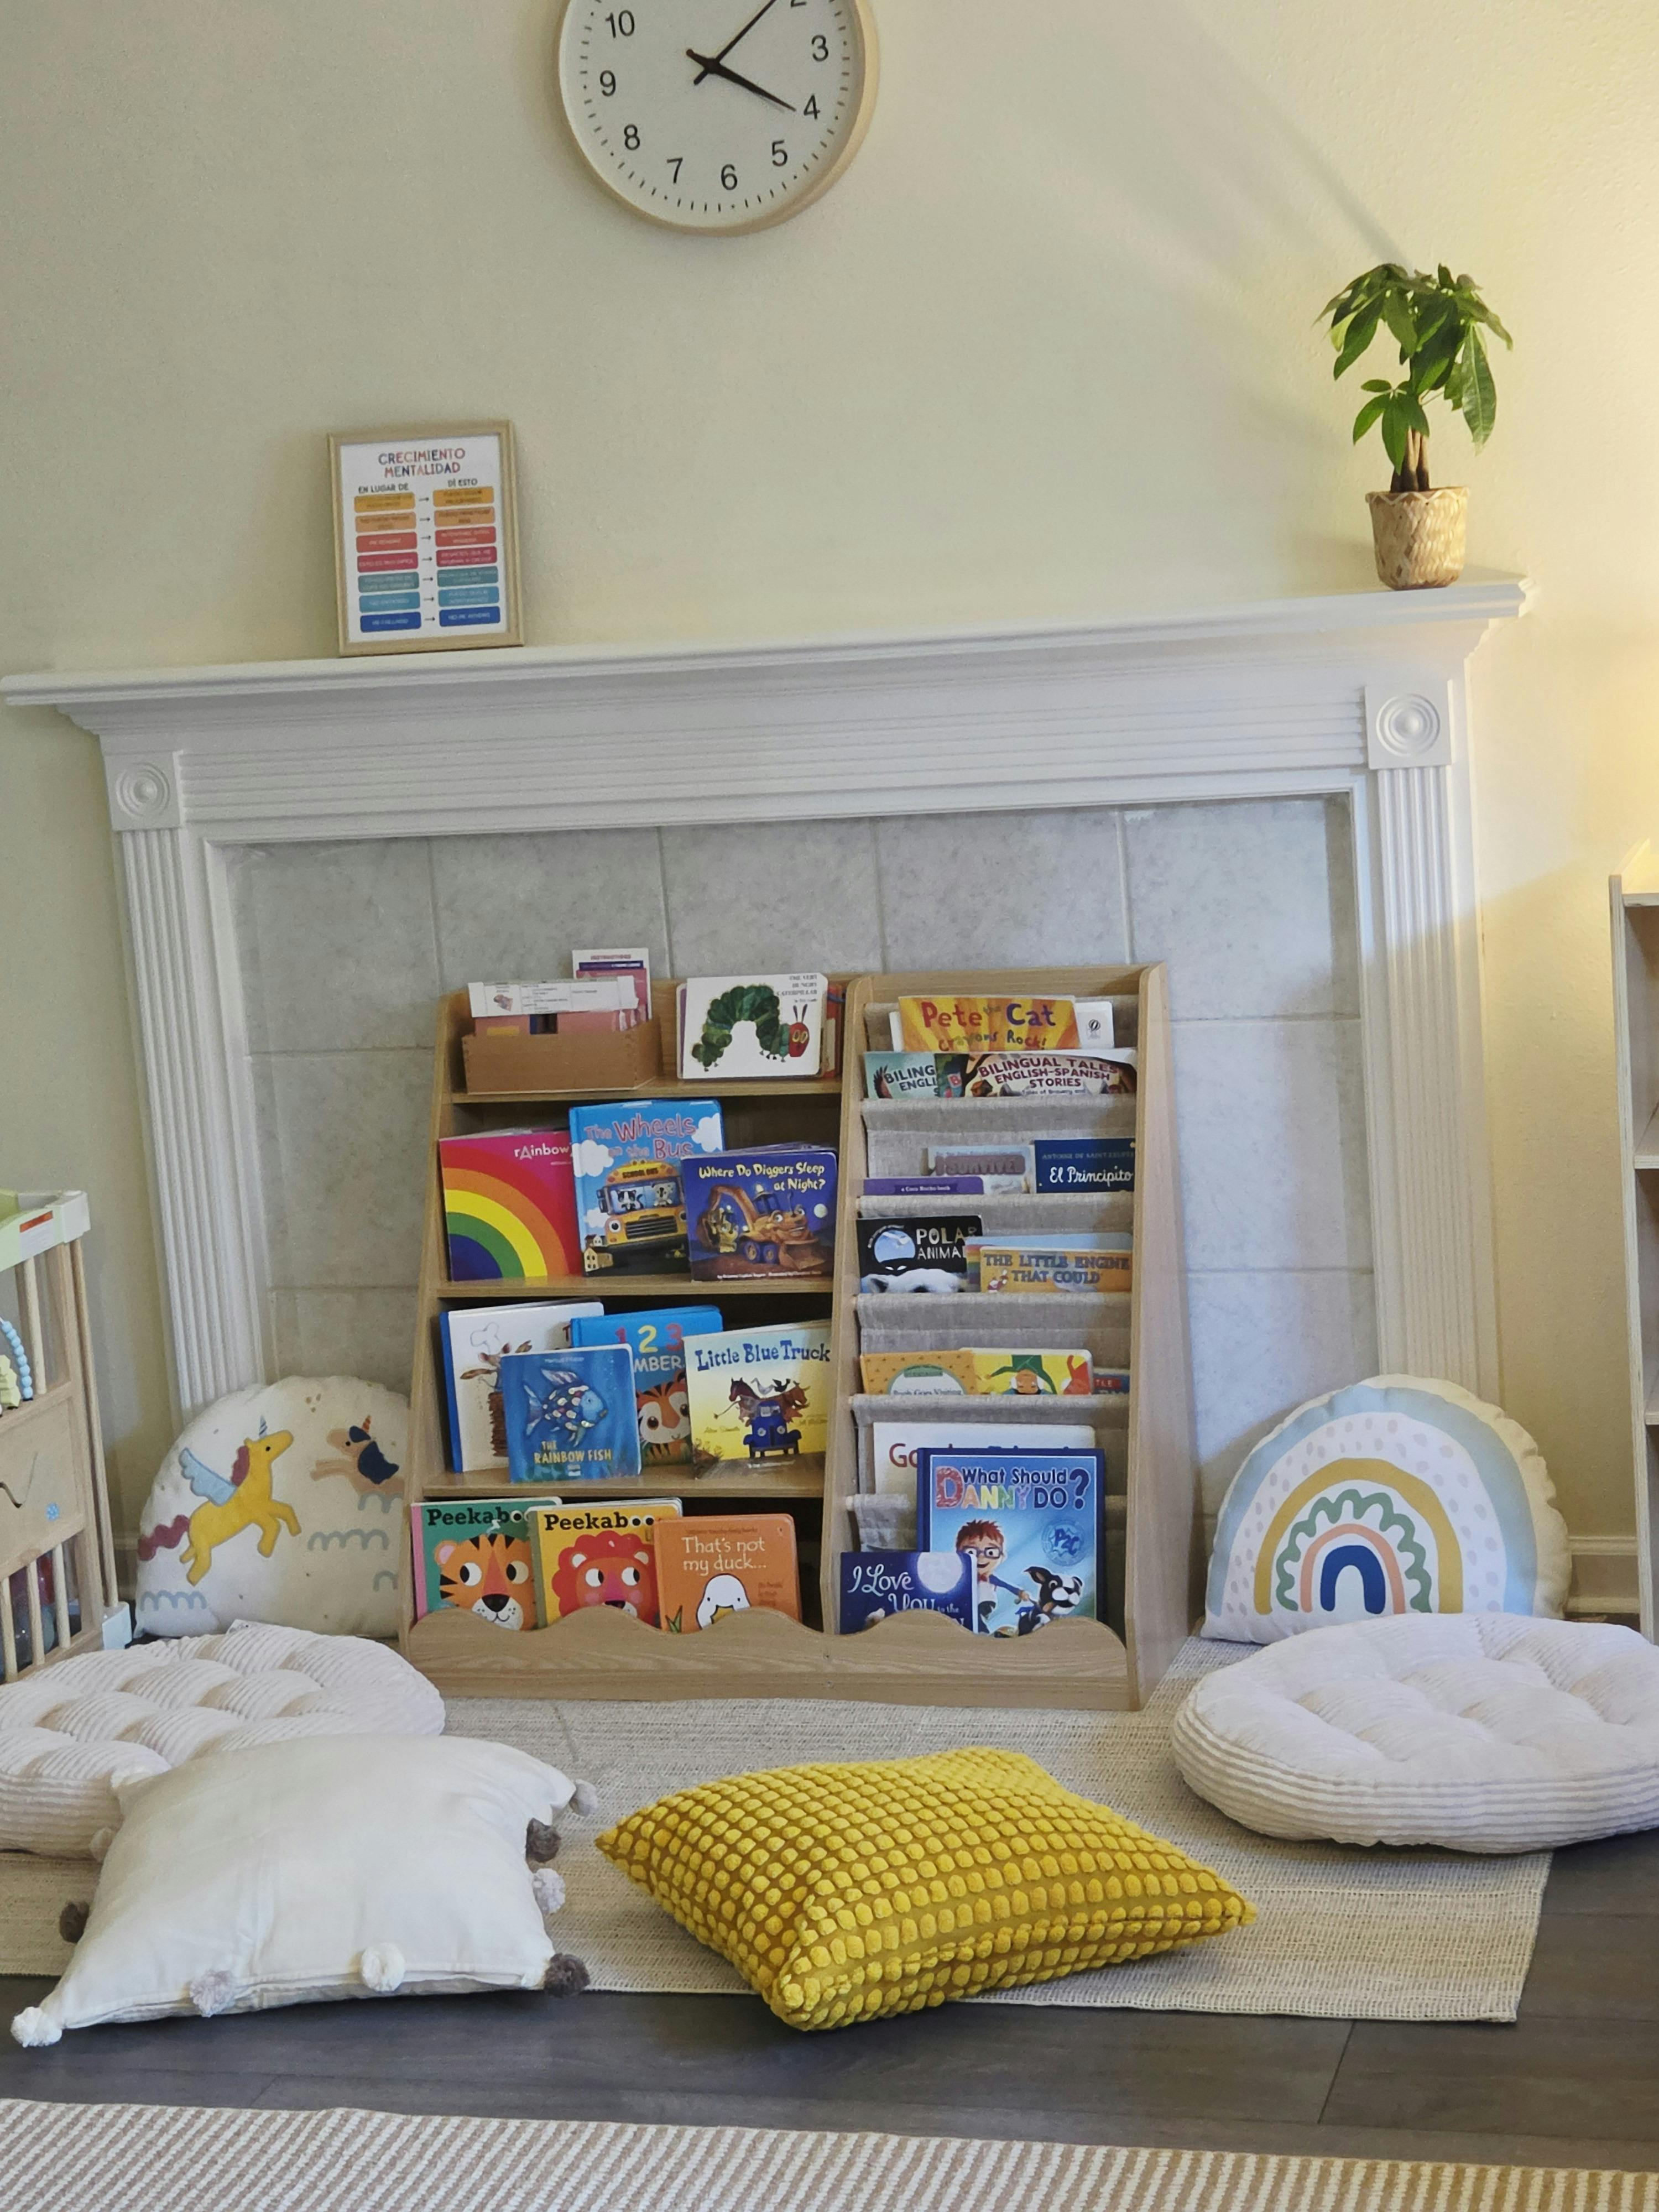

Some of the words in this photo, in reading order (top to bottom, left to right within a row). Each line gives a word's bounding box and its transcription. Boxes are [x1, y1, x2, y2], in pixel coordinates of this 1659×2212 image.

[606, 10, 635, 38] 10
[811, 35, 829, 62] 3
[599, 70, 617, 97] 9
[803, 95, 821, 121] 4
[623, 124, 640, 150] 8
[771, 140, 788, 166] 5
[667, 158, 684, 184] 7
[721, 164, 738, 191] 6
[378, 448, 465, 466] CRECIMIENTO
[384, 462, 461, 478] MENTALIDAD
[371, 484, 396, 493] LUGAR
[921, 1001, 983, 1028] Pete
[1006, 1003, 1056, 1027] Cat
[978, 1058, 1061, 1077] BILINGUAL
[1066, 1058, 1118, 1074] TALES
[994, 1068, 1110, 1084] ENGLISH-SPANISH
[899, 1078, 937, 1092] ENGLI
[1029, 1078, 1082, 1088] STORIES
[585, 1124, 612, 1140] The
[613, 1113, 697, 1142] Wheels
[625, 1145, 650, 1157] the
[653, 1138, 693, 1160] Bus
[698, 1166, 734, 1179] Where
[735, 1164, 752, 1177] Do
[752, 1163, 794, 1178] Diggers
[795, 1162, 825, 1176] Sleep
[1049, 1166, 1064, 1183] El
[1067, 1165, 1133, 1187] Principito
[774, 1181, 785, 1191] at
[787, 1178, 826, 1193] Night?
[984, 1254, 1013, 1266] THE
[1019, 1255, 1069, 1269] LITTLE
[1074, 1256, 1130, 1270] ENGINE
[1011, 1270, 1049, 1282] THAT
[1052, 1270, 1100, 1284] COULD
[615, 1328, 626, 1343] 1
[638, 1324, 658, 1353] 2
[666, 1322, 683, 1352] 3
[695, 1348, 740, 1371] Little
[743, 1343, 779, 1364] Blue
[780, 1339, 831, 1362] Truck
[534, 1451, 585, 1464] RAINBOW
[588, 1449, 613, 1461] FISH
[541, 1440, 557, 1451] THE
[962, 1467, 1005, 1484] What
[1012, 1467, 1067, 1485] Should
[935, 1466, 1031, 1510] DANNY
[681, 1536, 731, 1553] That's
[737, 1537, 765, 1552] not
[683, 1558, 709, 1577] my
[713, 1552, 767, 1572] duck...
[862, 1563, 915, 1597] Love
[946, 1603, 959, 1614] the
